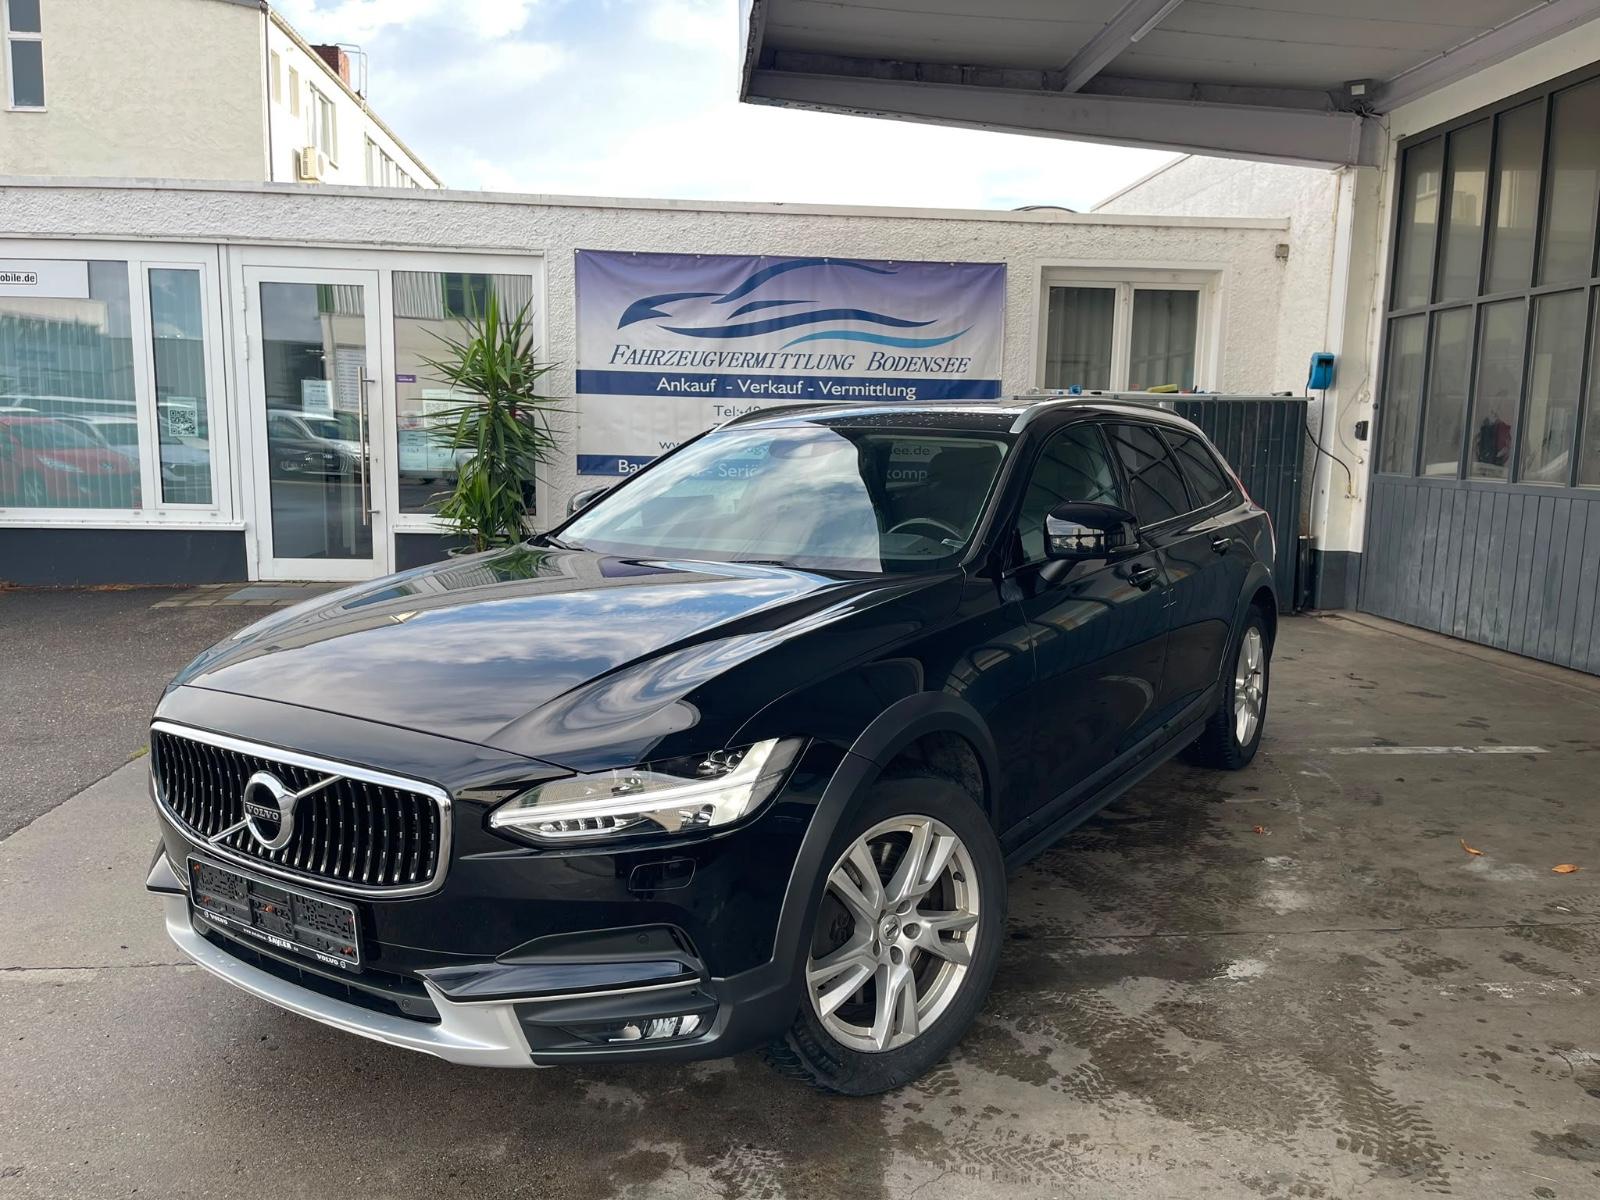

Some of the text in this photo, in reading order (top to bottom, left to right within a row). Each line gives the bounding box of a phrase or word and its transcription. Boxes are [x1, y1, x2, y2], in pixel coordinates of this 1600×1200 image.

[0, 273, 35, 283] obile.de
[609, 344, 971, 373] FAHRZEUGVERMITTLUNG BODENSEE
[656, 377, 717, 392] Ankauf
[737, 379, 803, 394] Verkauf
[819, 381, 916, 400] Vermittlung
[246, 804, 279, 820] VOLVO
[209, 913, 228, 925] VOLVO
[315, 953, 339, 965] VOLVO
